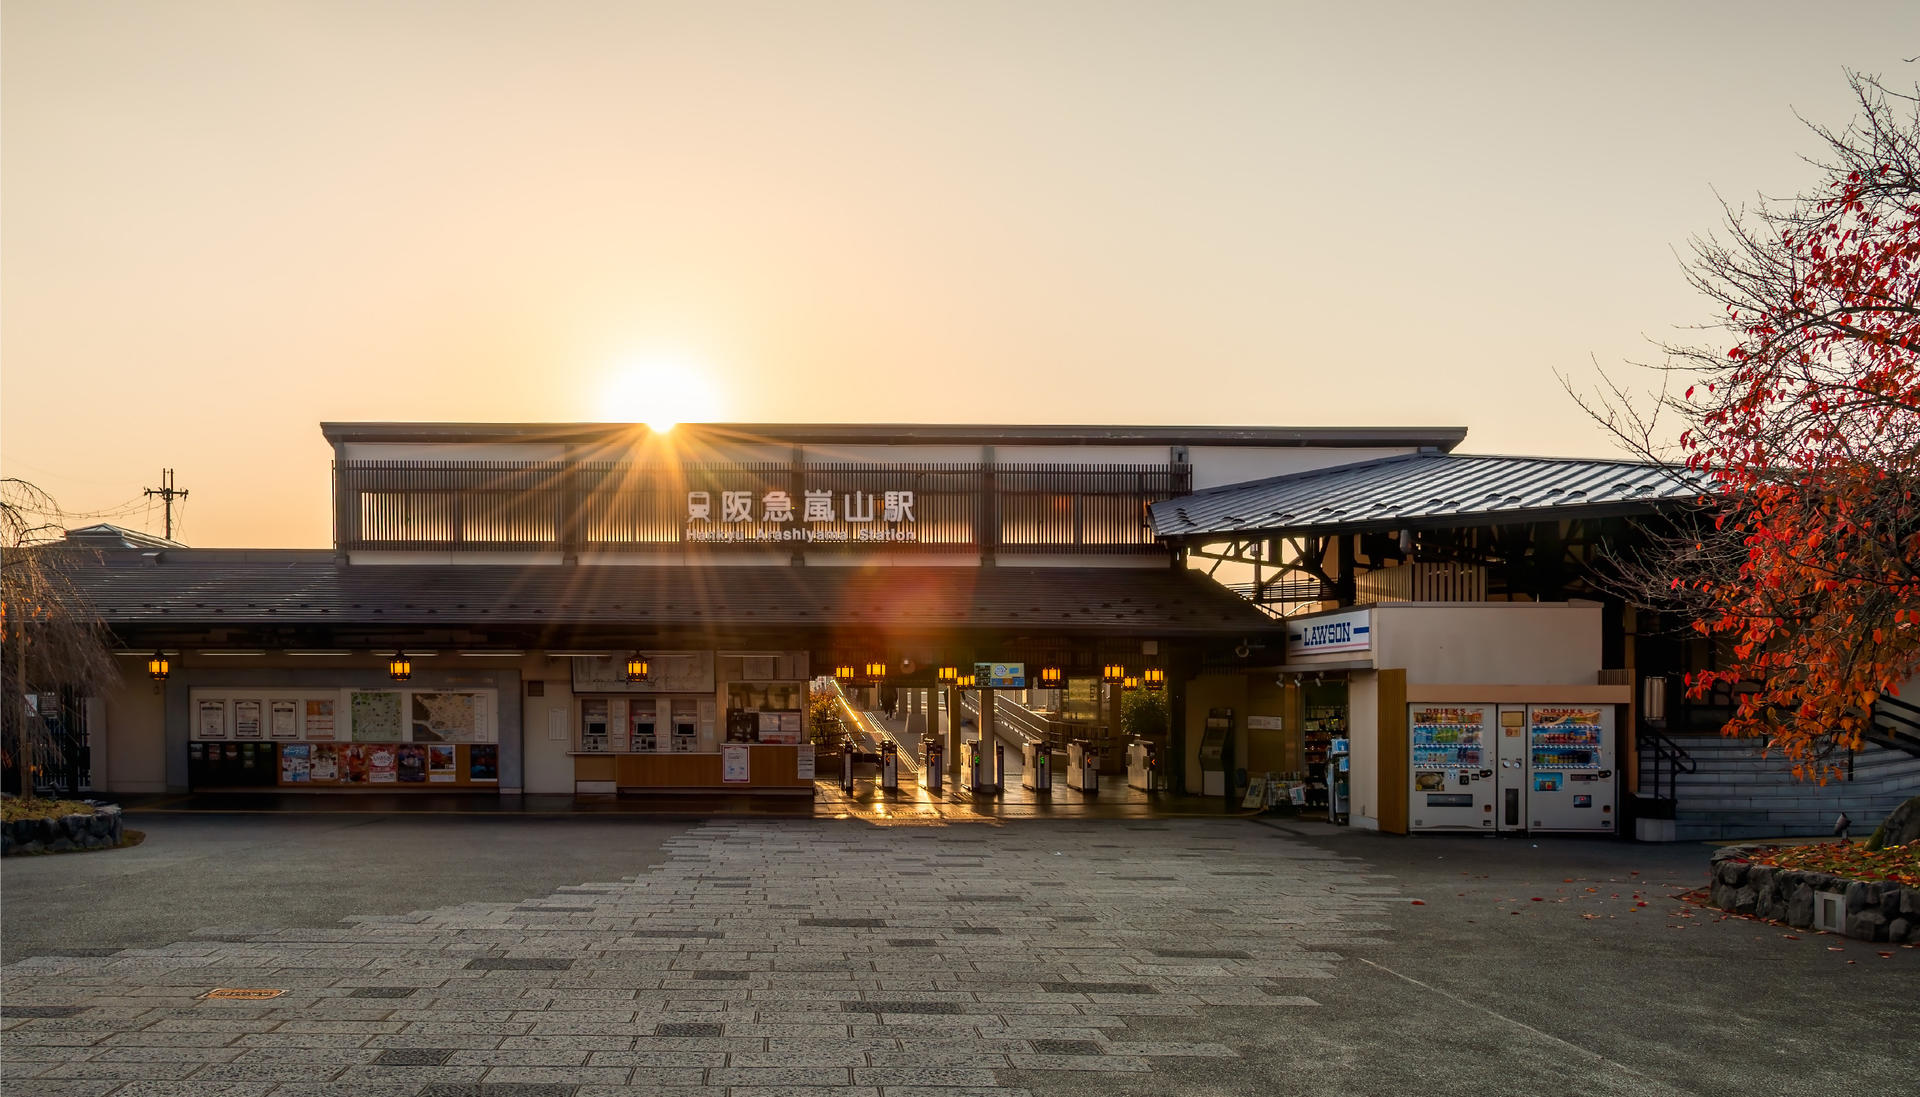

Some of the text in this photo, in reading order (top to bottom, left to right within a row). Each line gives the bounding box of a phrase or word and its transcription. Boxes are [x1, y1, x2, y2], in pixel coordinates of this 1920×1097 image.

[721, 489, 914, 522] 阪急嵐山駅
[686, 528, 914, 543] Hankyu Arashiyama Station
[1303, 621, 1350, 646] LAWSON
